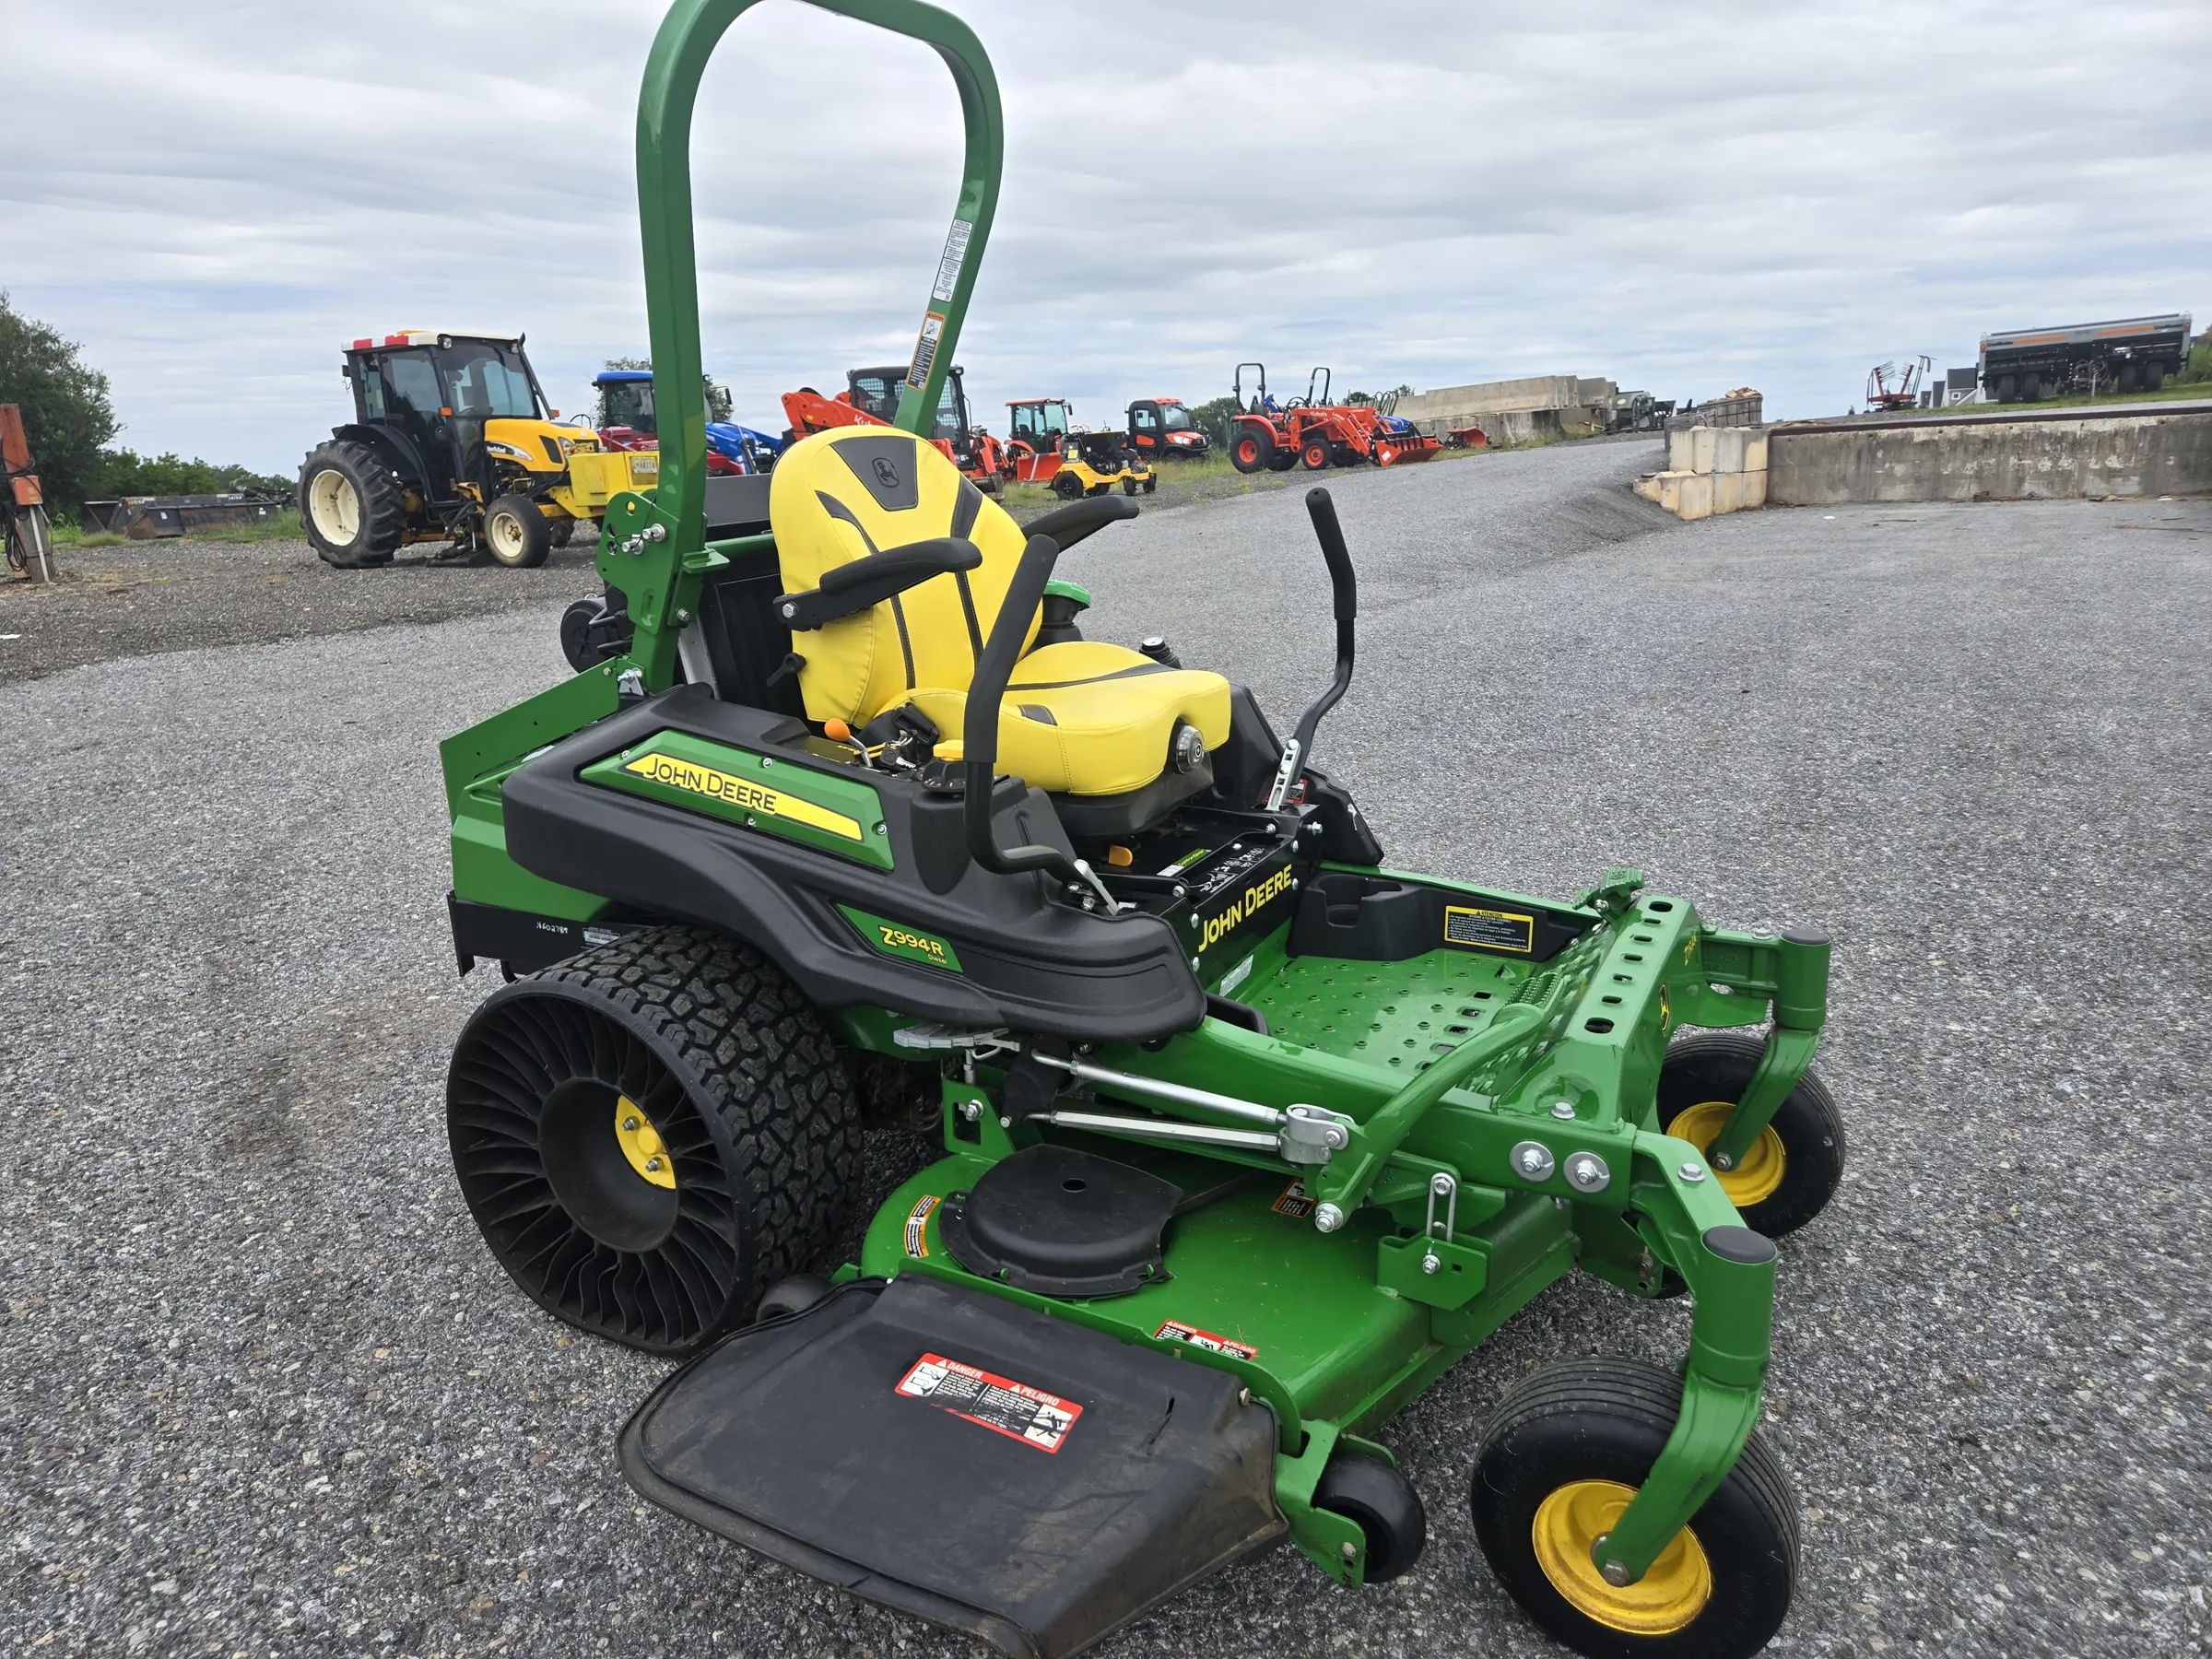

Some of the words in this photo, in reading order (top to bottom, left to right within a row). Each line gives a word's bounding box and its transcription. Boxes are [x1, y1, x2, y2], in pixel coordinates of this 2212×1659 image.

[646, 758, 702, 788] JOHN
[707, 773, 777, 812] DEERE
[1198, 900, 1241, 953] JOHN
[1245, 864, 1292, 917] DEERE
[879, 926, 945, 956] Z994R
[927, 953, 947, 964] Diesel
[1173, 1322, 1197, 1335] DANGER
[1230, 1341, 1257, 1354] PELIGRO
[947, 1359, 984, 1379] DANGER
[1020, 1386, 1060, 1407] PELIGRO
